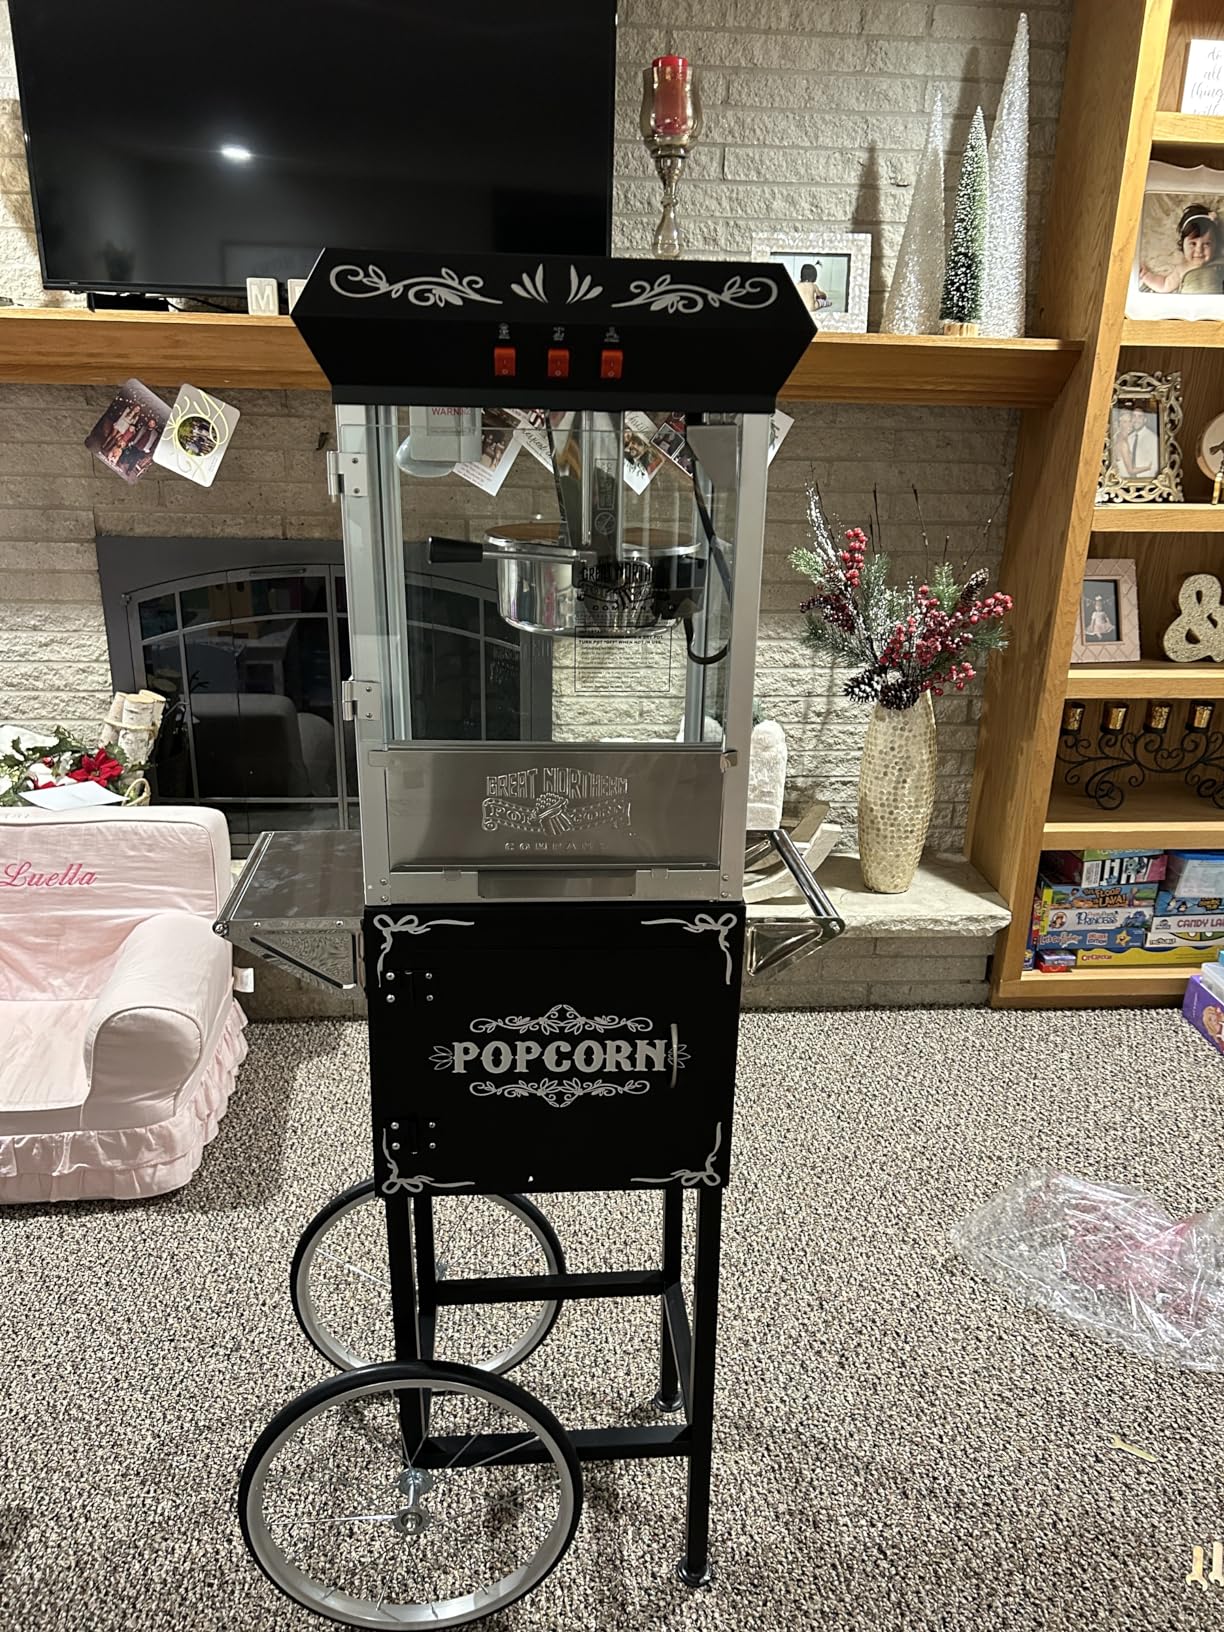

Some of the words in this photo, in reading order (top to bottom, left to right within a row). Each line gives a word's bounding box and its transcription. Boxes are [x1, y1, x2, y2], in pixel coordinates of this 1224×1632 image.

[1190, 82, 1224, 104] thing
[251, 285, 274, 310] M
[486, 767, 538, 799] GREAT
[543, 767, 628, 799] NORTHERN
[0, 861, 98, 887] Luella
[1177, 918, 1209, 928] CANDY
[452, 1040, 668, 1074] POPCORN
